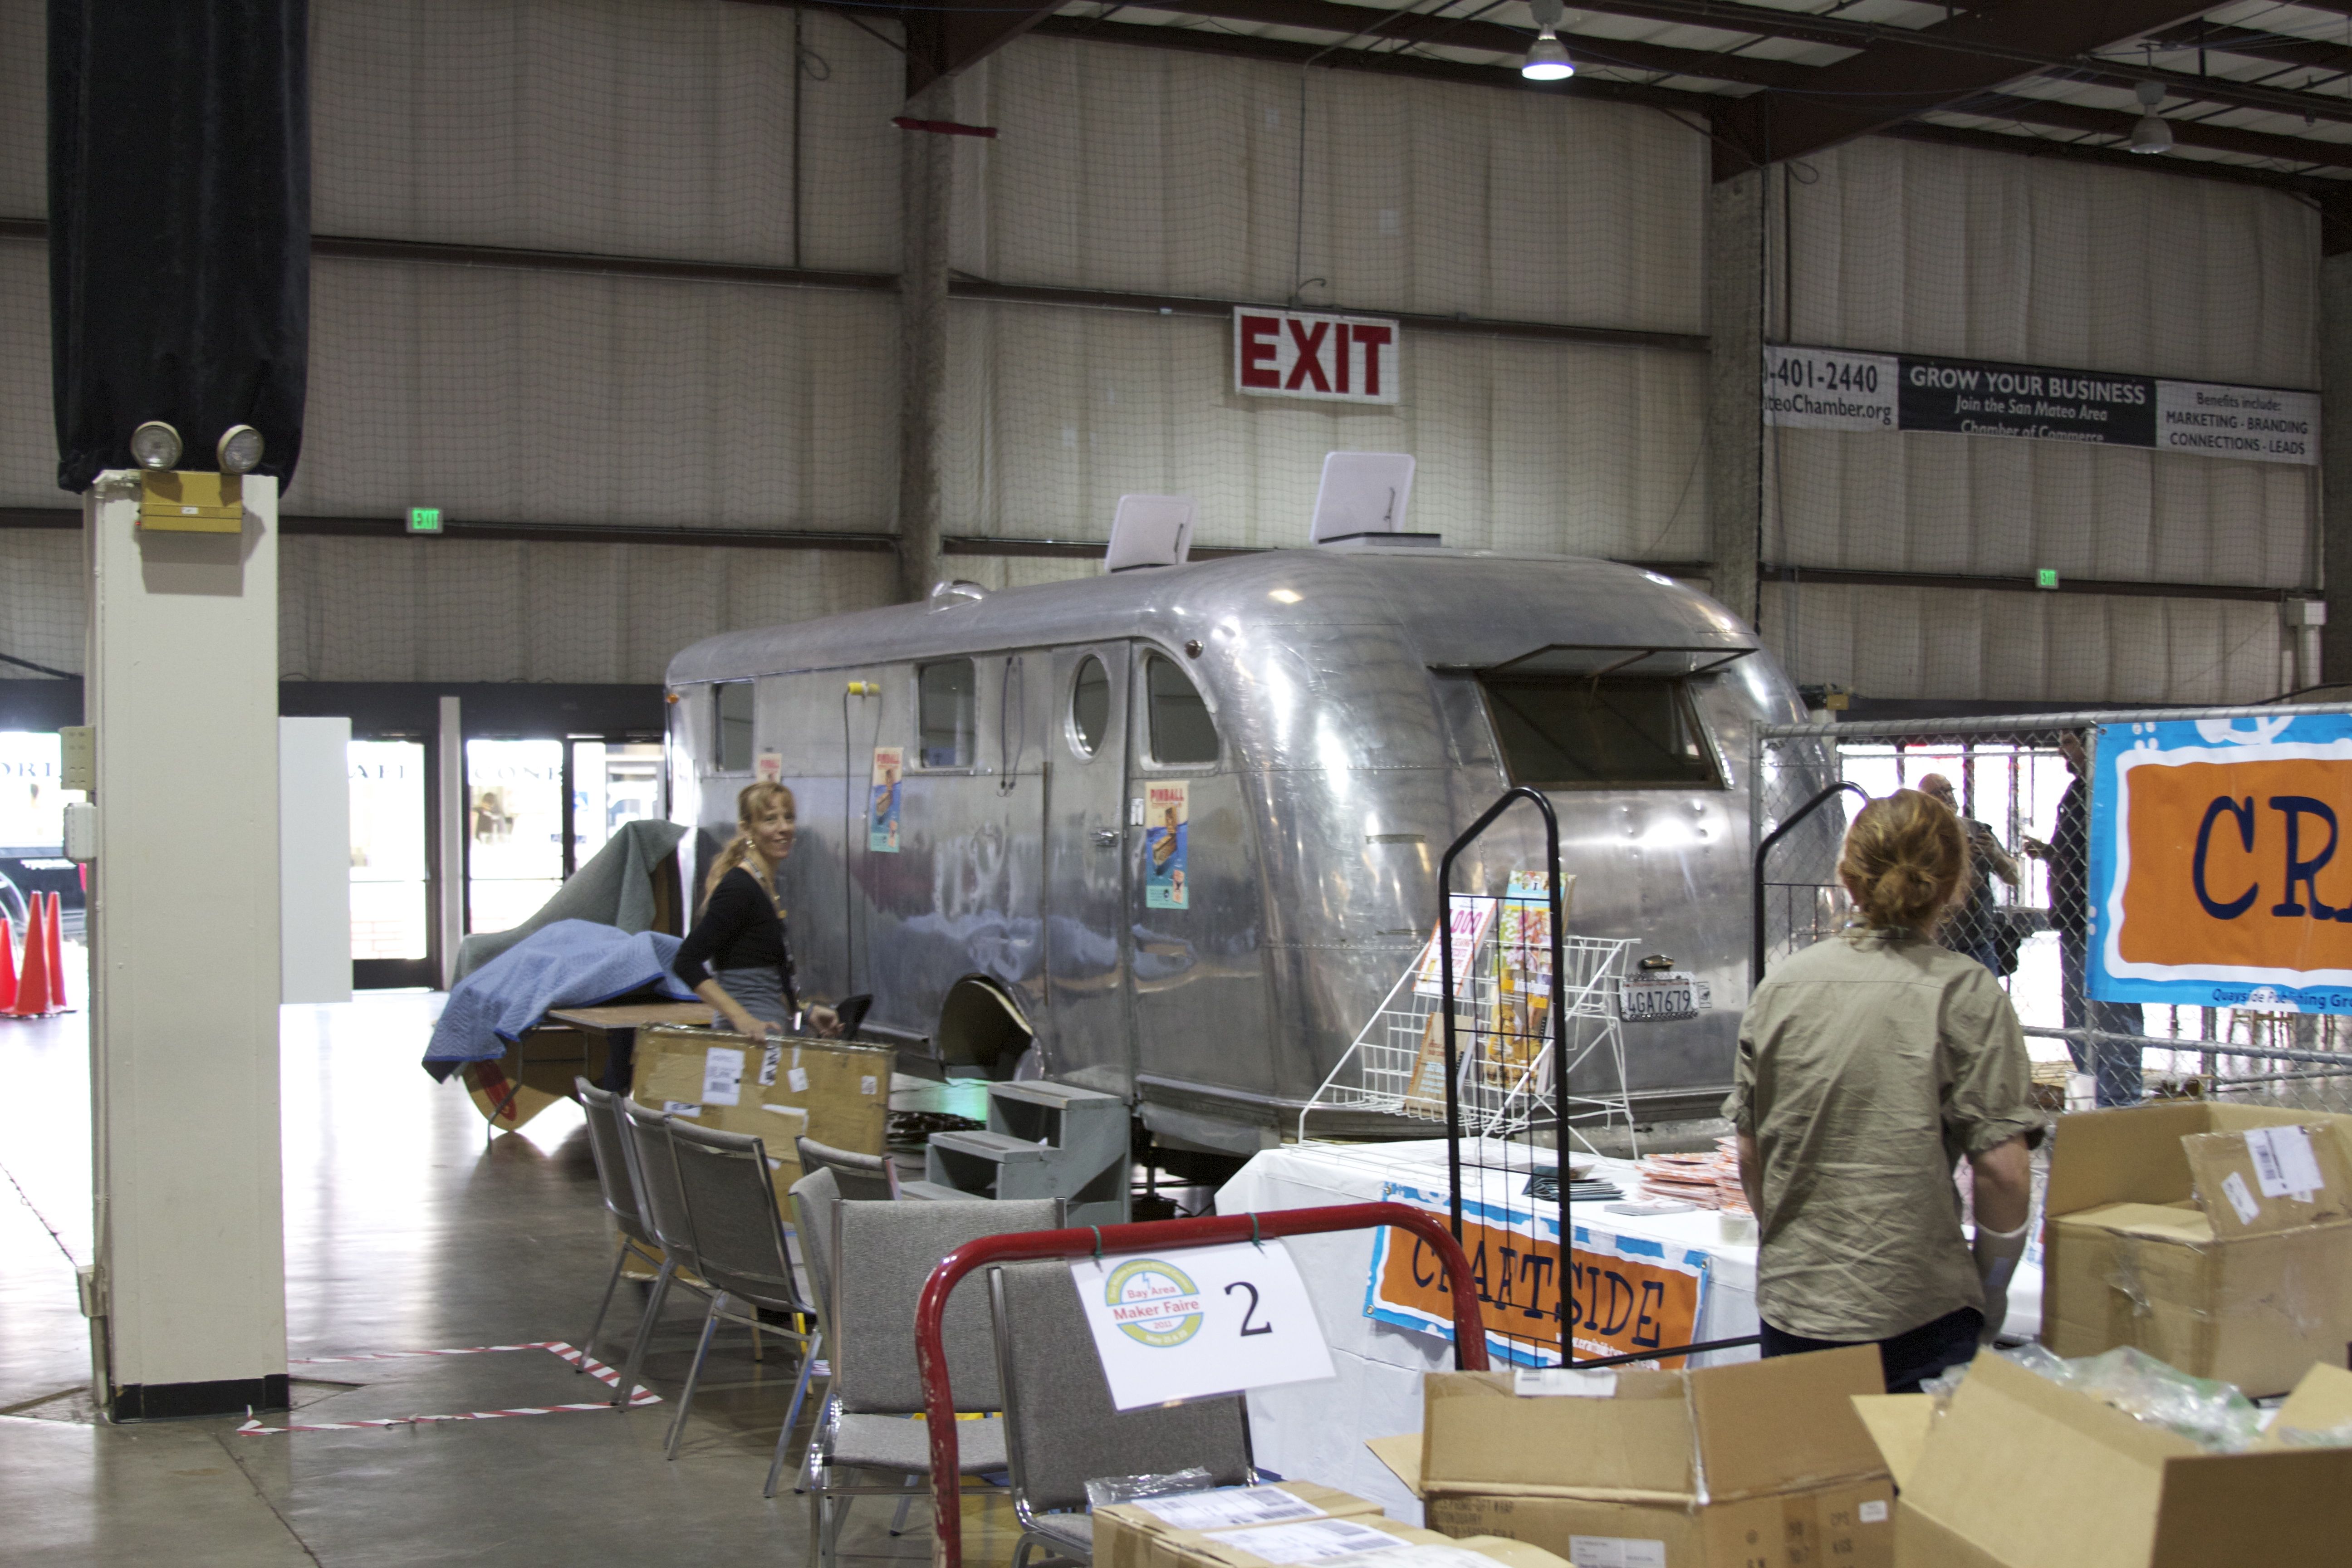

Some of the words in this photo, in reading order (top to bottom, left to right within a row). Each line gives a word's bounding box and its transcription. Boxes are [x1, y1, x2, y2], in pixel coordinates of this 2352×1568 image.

[1241, 315, 1392, 396] EXIT
[1910, 366, 1980, 391] GROW
[1986, 372, 2044, 397] YOUR
[2049, 377, 2146, 405] BUSINESS
[1764, 394, 1891, 426] teoChamber.org
[1955, 395, 1981, 413] Join
[1984, 397, 2005, 413] the
[2009, 399, 2031, 415] San
[2035, 401, 2076, 418] Mateo
[2079, 406, 2107, 421] Area
[2196, 392, 2239, 408] Benefits
[1961, 420, 2019, 437] Chamber
[2023, 424, 2035, 438] of
[2166, 411, 2238, 429] MARKETING
[2247, 417, 2308, 434] BRANDING
[2170, 432, 2260, 451] CONNECTIONS
[2269, 439, 2305, 455] LEADS
[412, 509, 439, 529] EXIT
[2192, 795, 2352, 923] CR
[1127, 1289, 1147, 1298] Bay
[1152, 1286, 1176, 1295] Area
[1413, 1238, 1664, 1348] CAFTSIDE
[1113, 1306, 1160, 1320] Maker
[1163, 1300, 1200, 1313] Faire
[1224, 1281, 1273, 1337] 2
